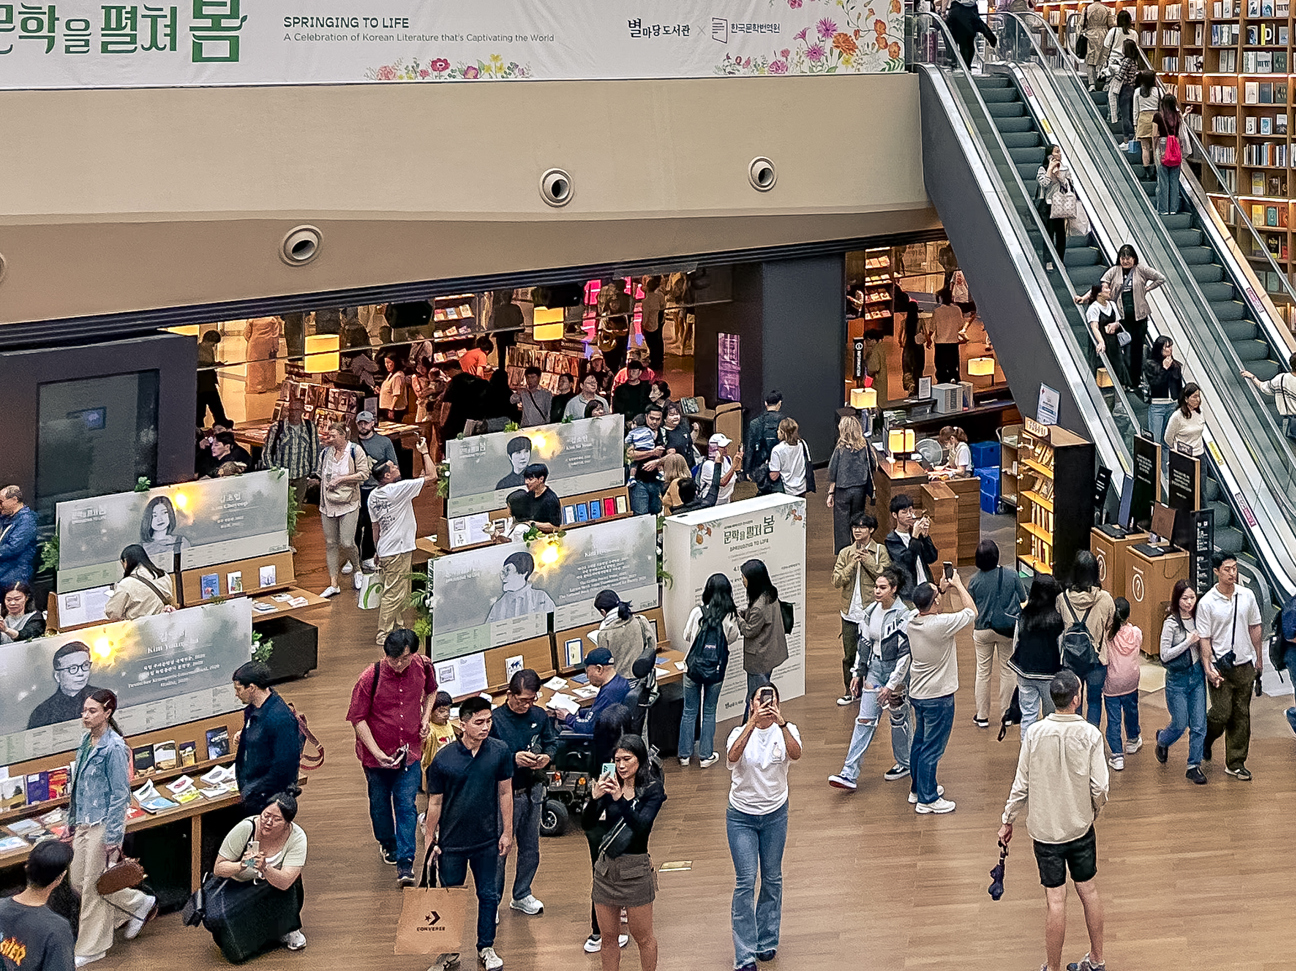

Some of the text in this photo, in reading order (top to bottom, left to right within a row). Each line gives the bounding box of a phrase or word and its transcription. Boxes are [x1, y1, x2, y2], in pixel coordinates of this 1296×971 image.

[100, 4, 178, 55] 펼쳐
[283, 16, 410, 29] SPRINGING TO LIFE
[627, 18, 691, 39] 별마당 도서관
[730, 23, 781, 34] 한국문학번역원
[284, 32, 554, 44] A Celebration of Korean Literature that's Captivating the World
[764, 515, 775, 535] 봄
